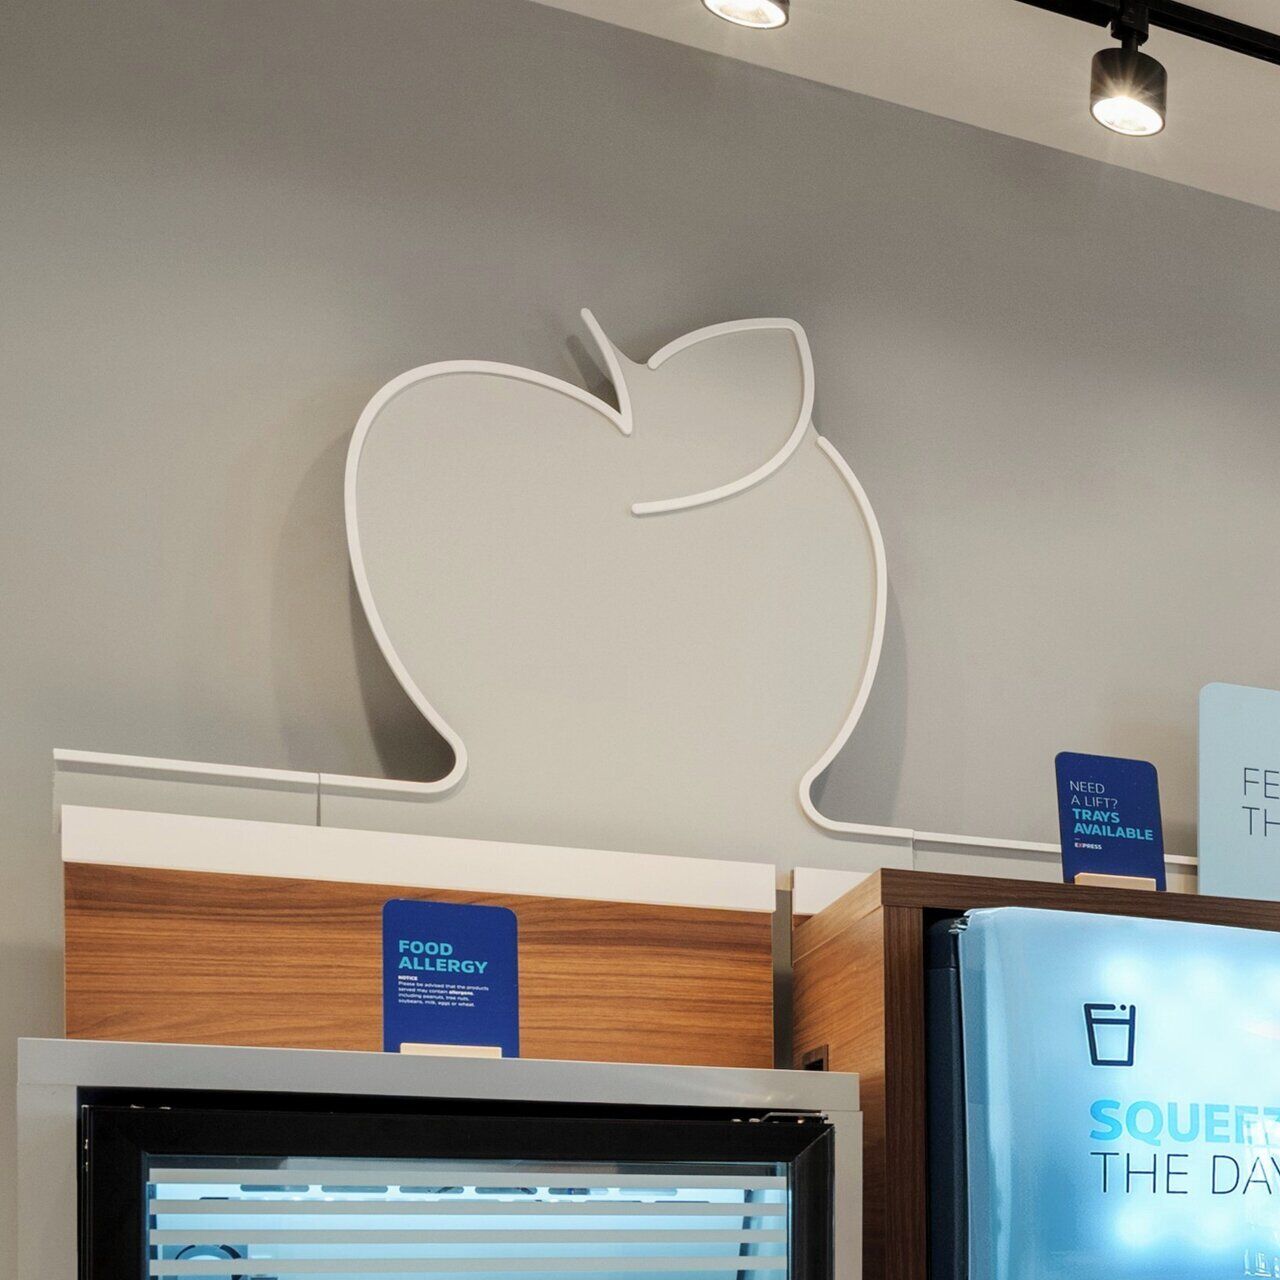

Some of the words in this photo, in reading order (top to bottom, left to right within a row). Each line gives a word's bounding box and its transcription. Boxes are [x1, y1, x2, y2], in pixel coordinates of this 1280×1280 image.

[1069, 780, 1105, 794] NEED
[1071, 794, 1081, 806] A
[1084, 796, 1118, 809] LIFT?
[1072, 807, 1120, 823] TRAYS
[1073, 822, 1154, 841] AVAILABLE
[1074, 842, 1102, 850] EXPRESS
[398, 939, 454, 956] FOOD
[398, 956, 489, 974] ALLERGY
[1089, 1151, 1189, 1194] THE
